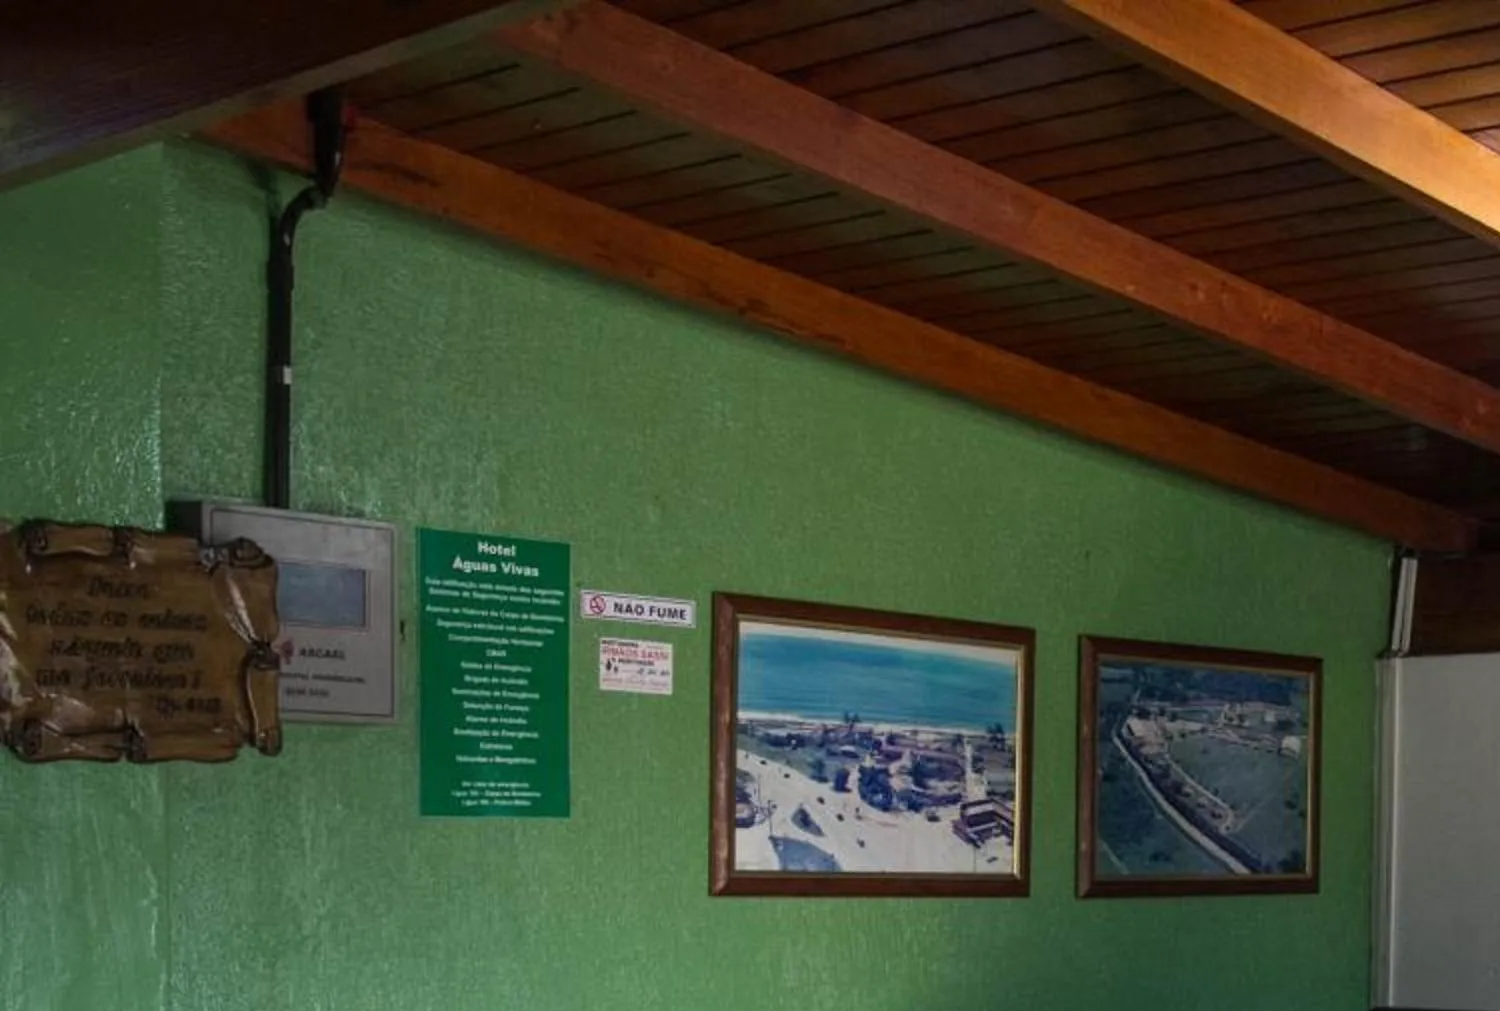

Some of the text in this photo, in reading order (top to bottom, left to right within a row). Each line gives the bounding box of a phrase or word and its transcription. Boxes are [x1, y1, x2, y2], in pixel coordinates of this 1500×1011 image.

[477, 540, 516, 557] Hotel
[452, 553, 540, 577] Águas Vivas
[649, 605, 687, 620] FUME
